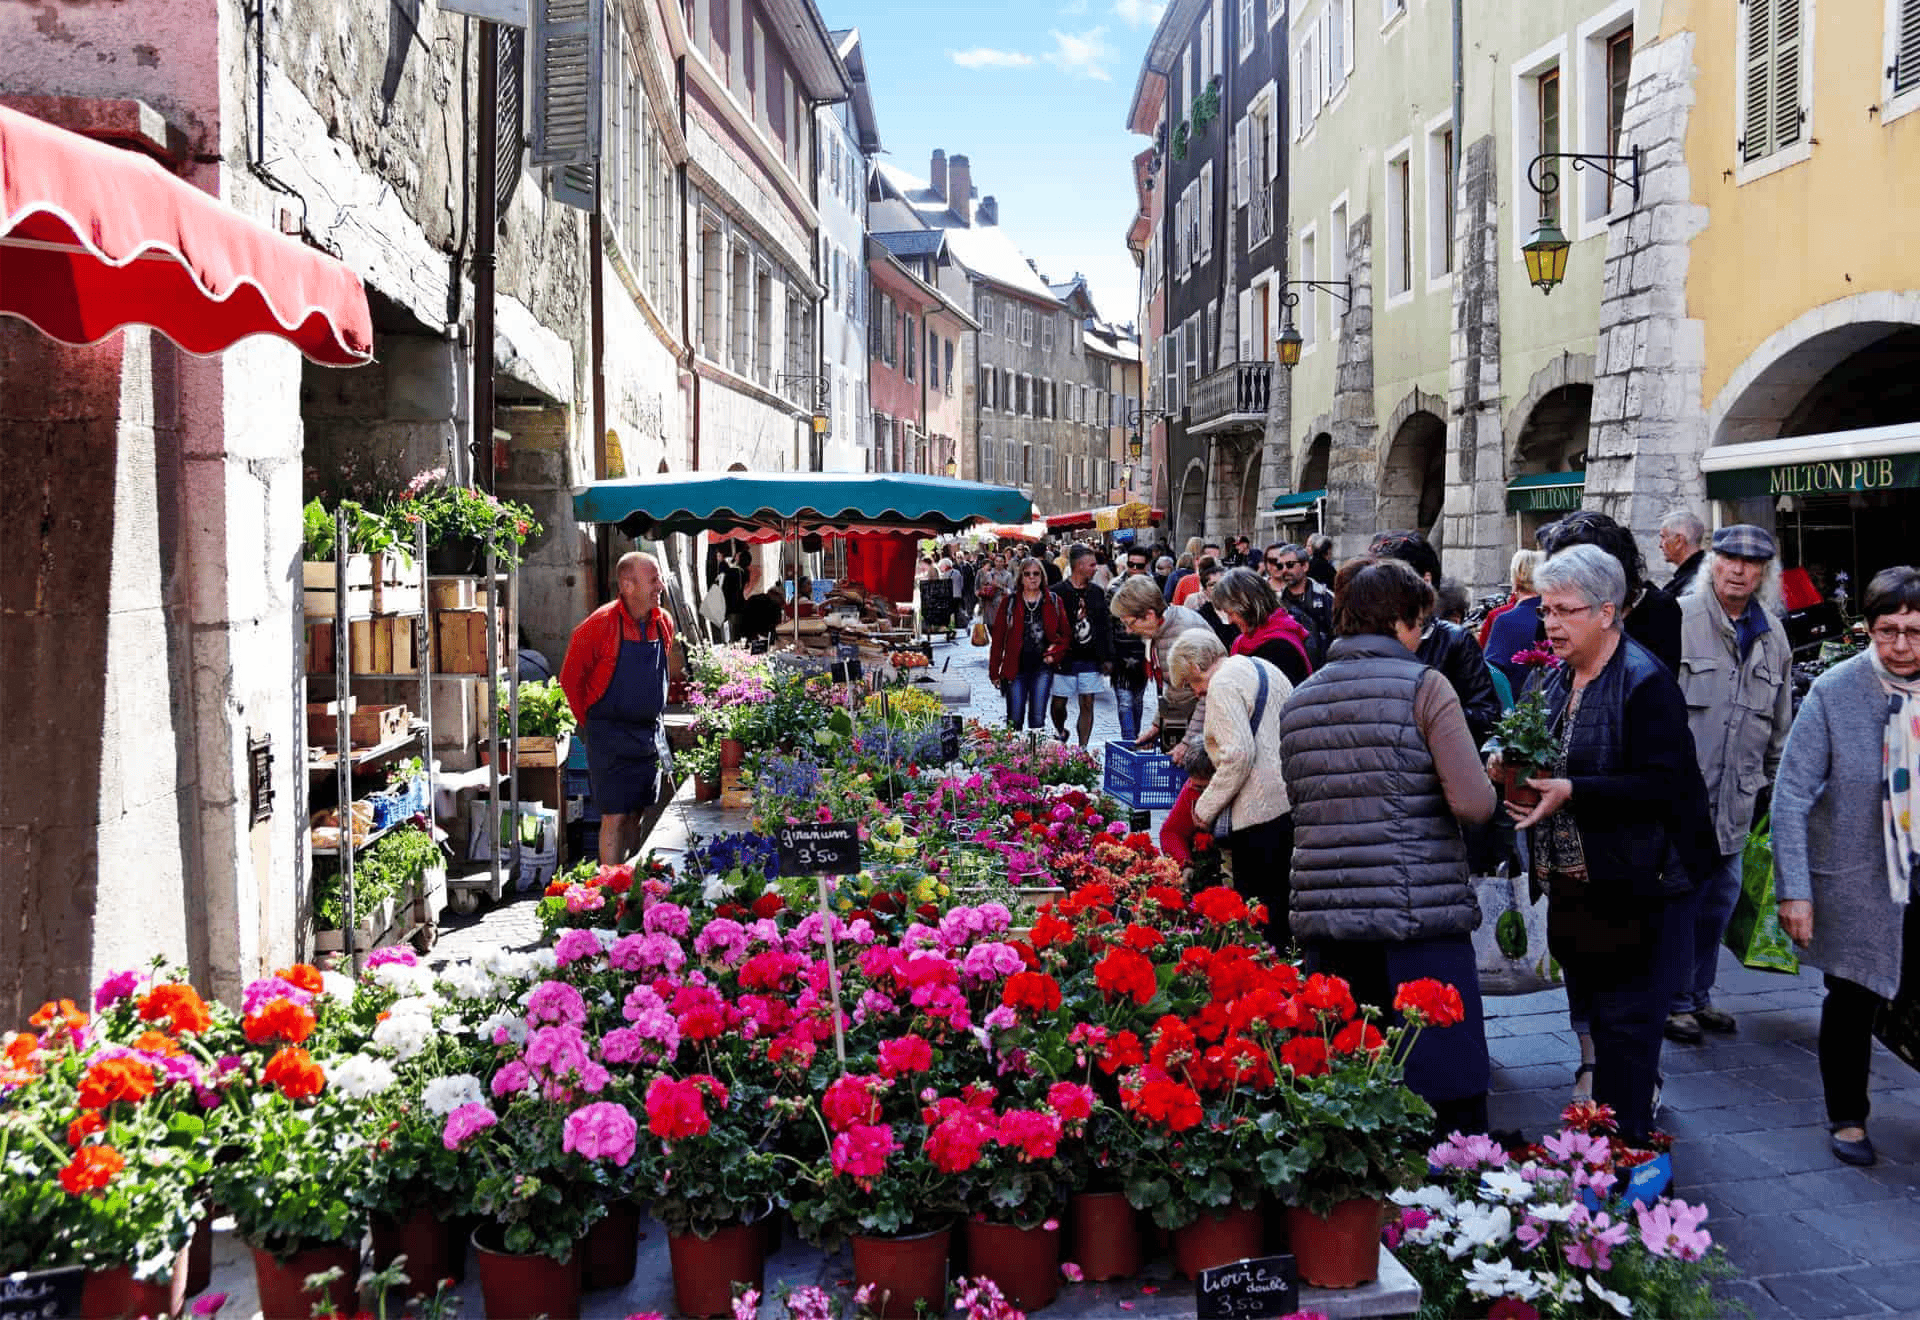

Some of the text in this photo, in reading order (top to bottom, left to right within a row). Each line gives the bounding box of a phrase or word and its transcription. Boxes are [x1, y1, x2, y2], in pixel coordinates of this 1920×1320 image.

[1770, 459, 1894, 493] MILTON PUB
[1529, 487, 1570, 509] MILTON
